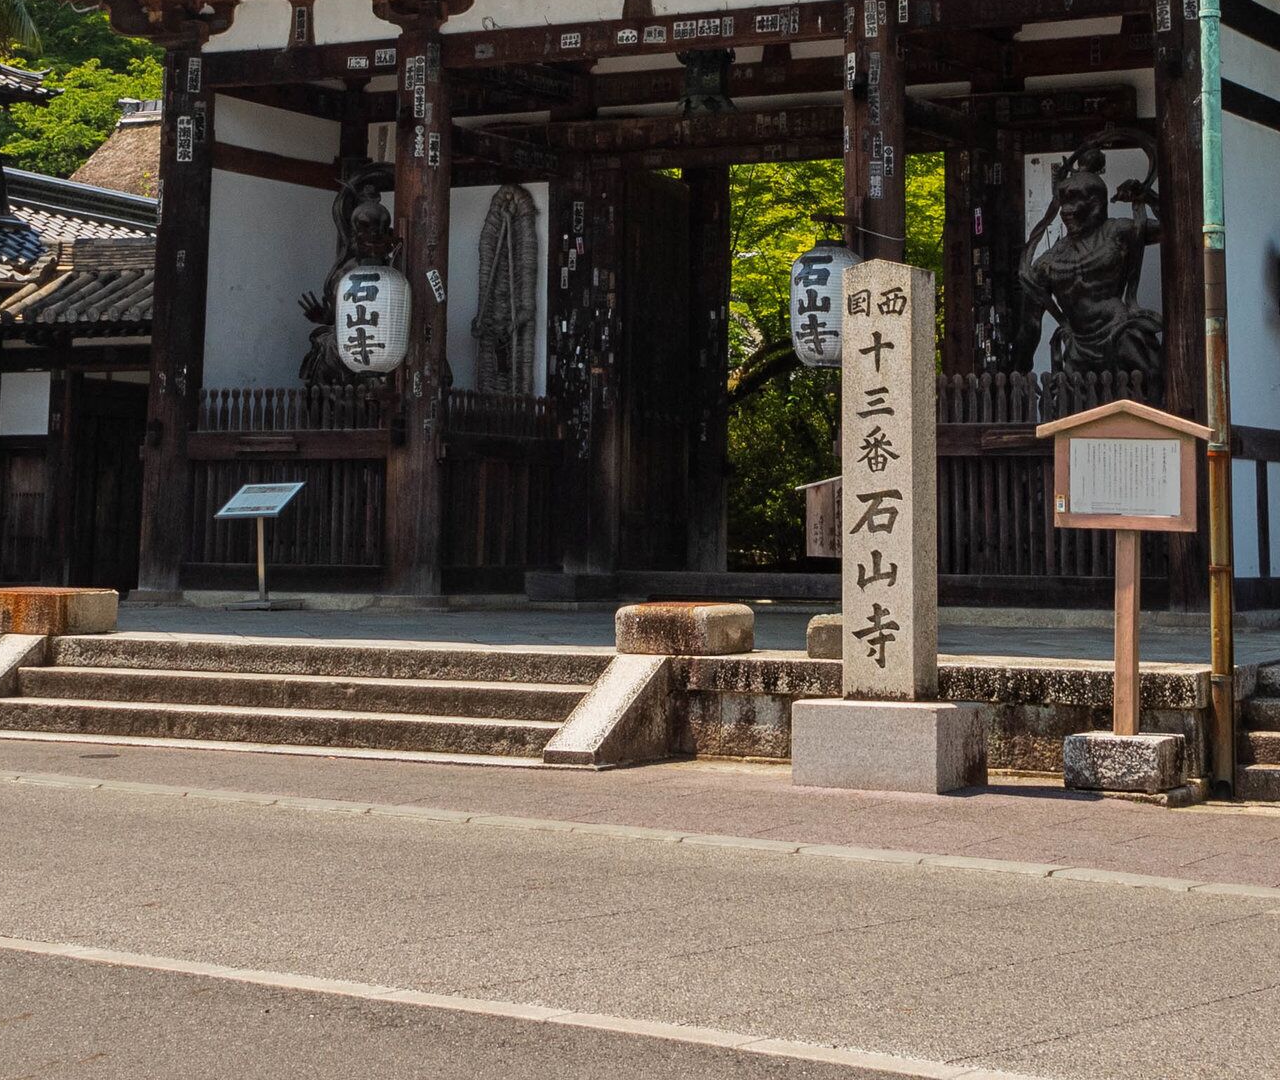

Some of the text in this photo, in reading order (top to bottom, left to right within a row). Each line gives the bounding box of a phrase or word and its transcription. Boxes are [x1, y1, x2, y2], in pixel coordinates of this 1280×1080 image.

[343, 273, 385, 366] 石山寺
[794, 255, 840, 356] 石山寺
[849, 330, 904, 669] 十三番石山寺
